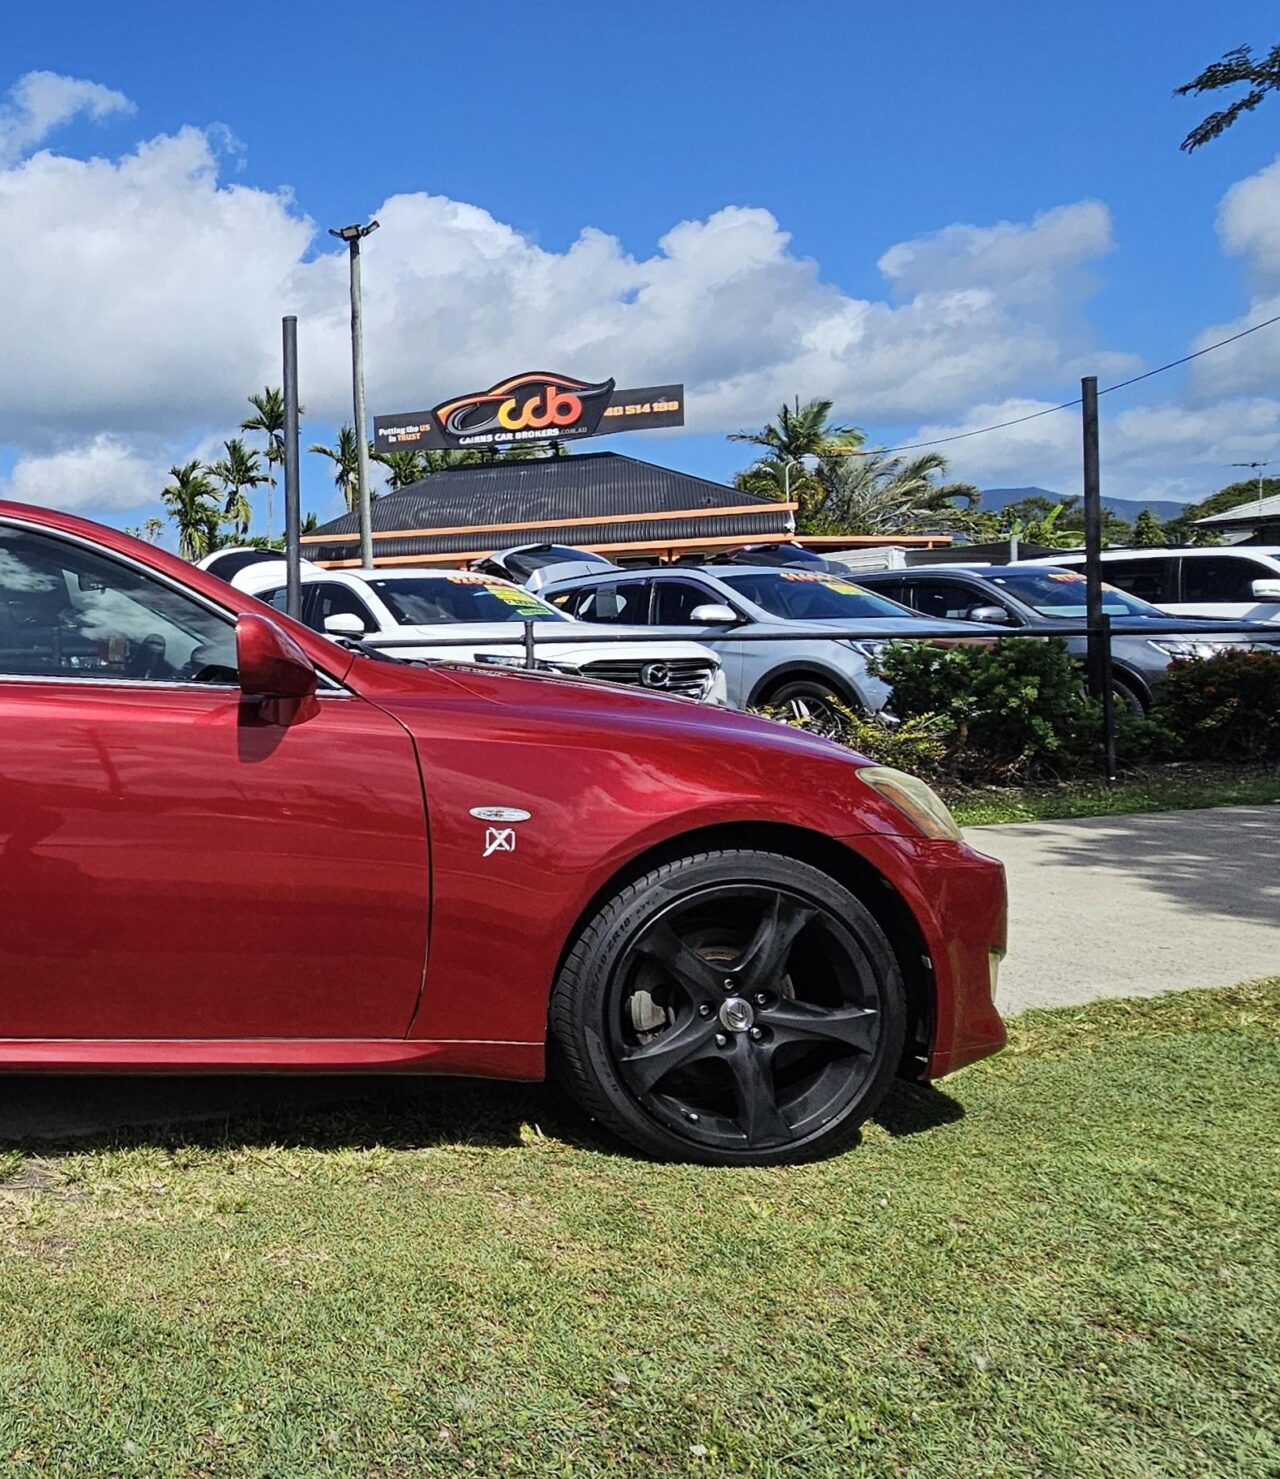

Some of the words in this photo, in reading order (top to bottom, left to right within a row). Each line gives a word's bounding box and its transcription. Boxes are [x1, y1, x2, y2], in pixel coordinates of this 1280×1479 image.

[625, 403, 651, 415] 514
[378, 426, 406, 436] Putting
[406, 425, 419, 433] the
[419, 424, 431, 432] US
[396, 432, 421, 442] TRUST
[459, 435, 493, 445] CAIRNS
[494, 432, 513, 441] CAR
